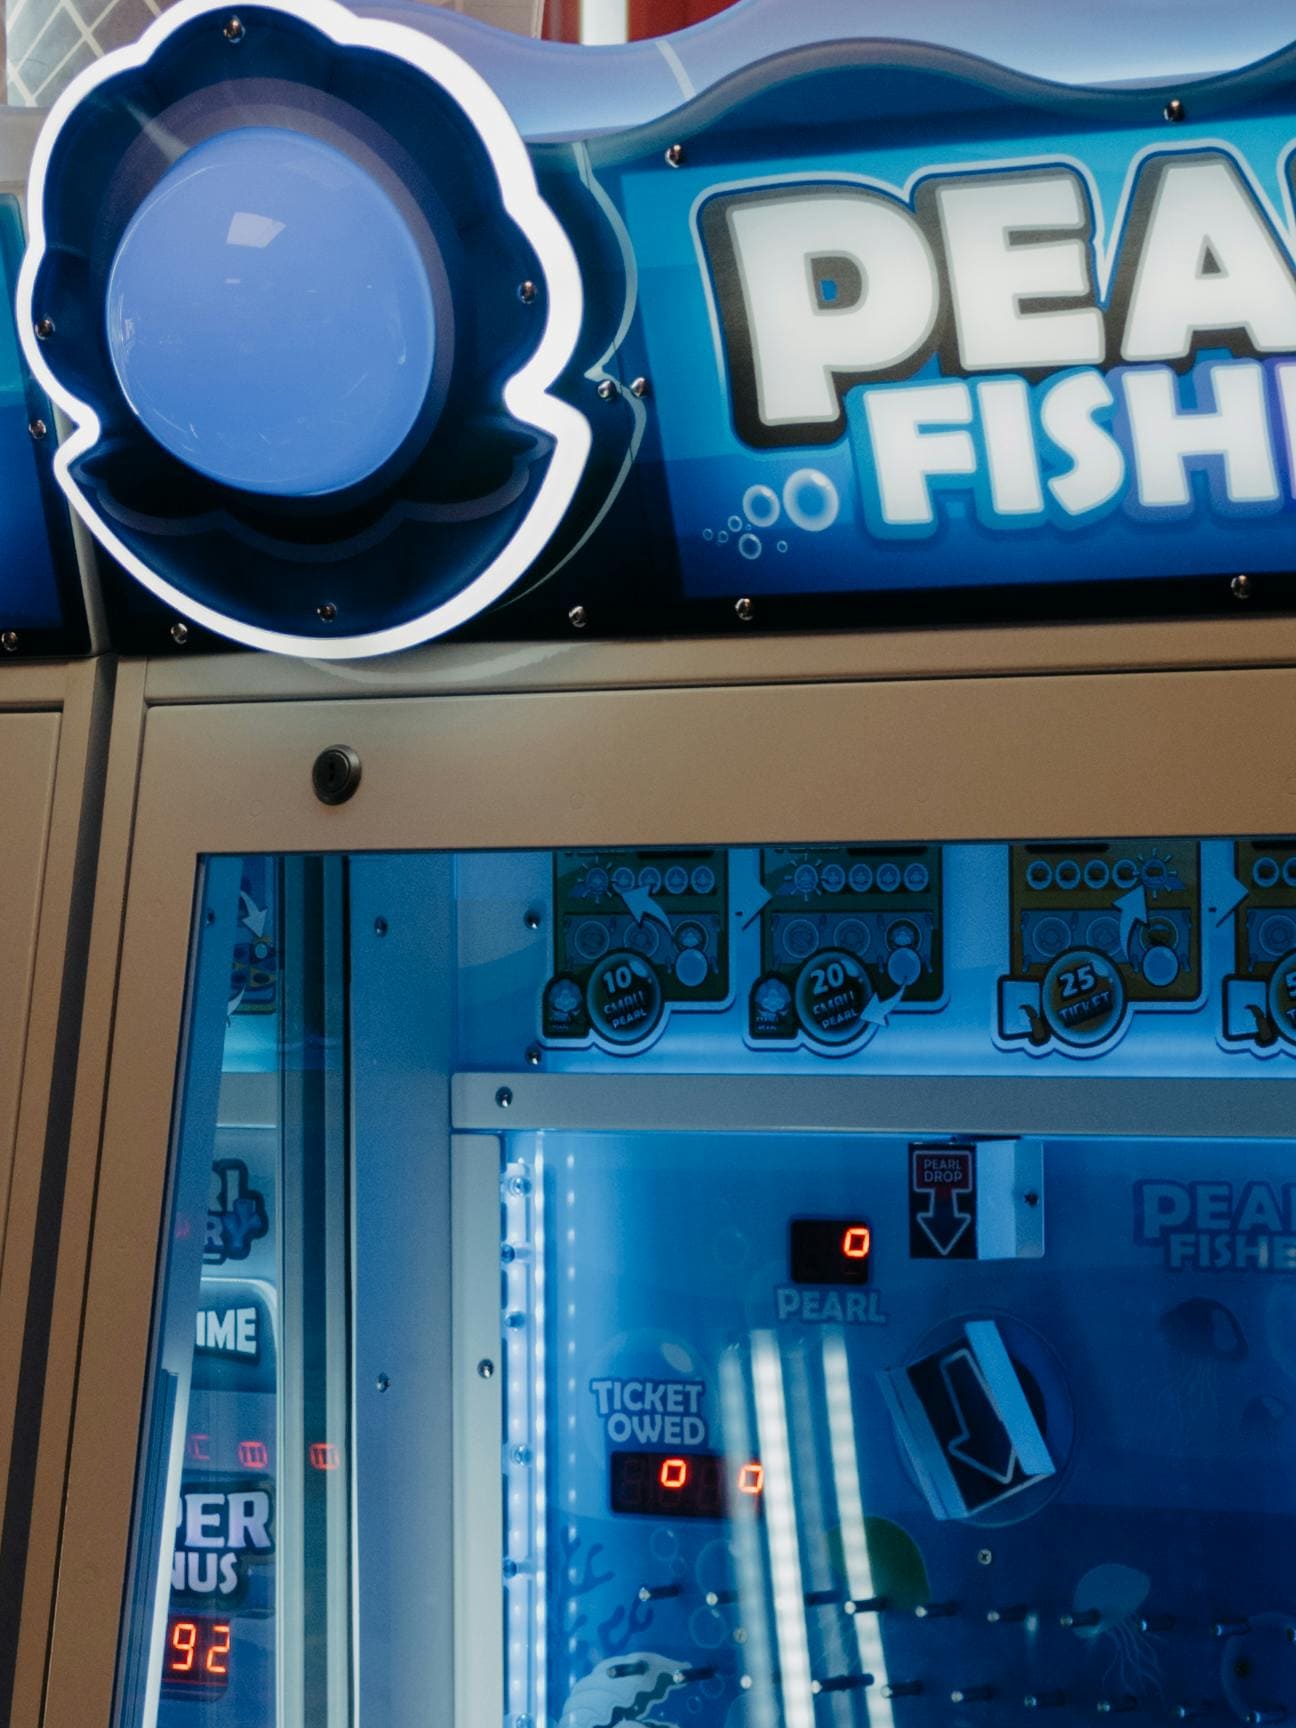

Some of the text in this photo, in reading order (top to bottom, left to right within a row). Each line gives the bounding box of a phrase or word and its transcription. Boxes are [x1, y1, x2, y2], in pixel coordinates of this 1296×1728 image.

[862, 358, 1296, 525] FISH
[602, 963, 633, 994] 10
[809, 962, 846, 995] 20
[1059, 964, 1097, 999] 25
[1058, 991, 1114, 1027] TICKET
[923, 1158, 963, 1171] PEARL
[923, 1170, 964, 1184] DROP
[843, 1225, 870, 1258] 0
[777, 1288, 886, 1323] PEARL
[591, 1379, 705, 1417] TICKET
[607, 1411, 706, 1447] OWED
[660, 1458, 764, 1495] 0 0
